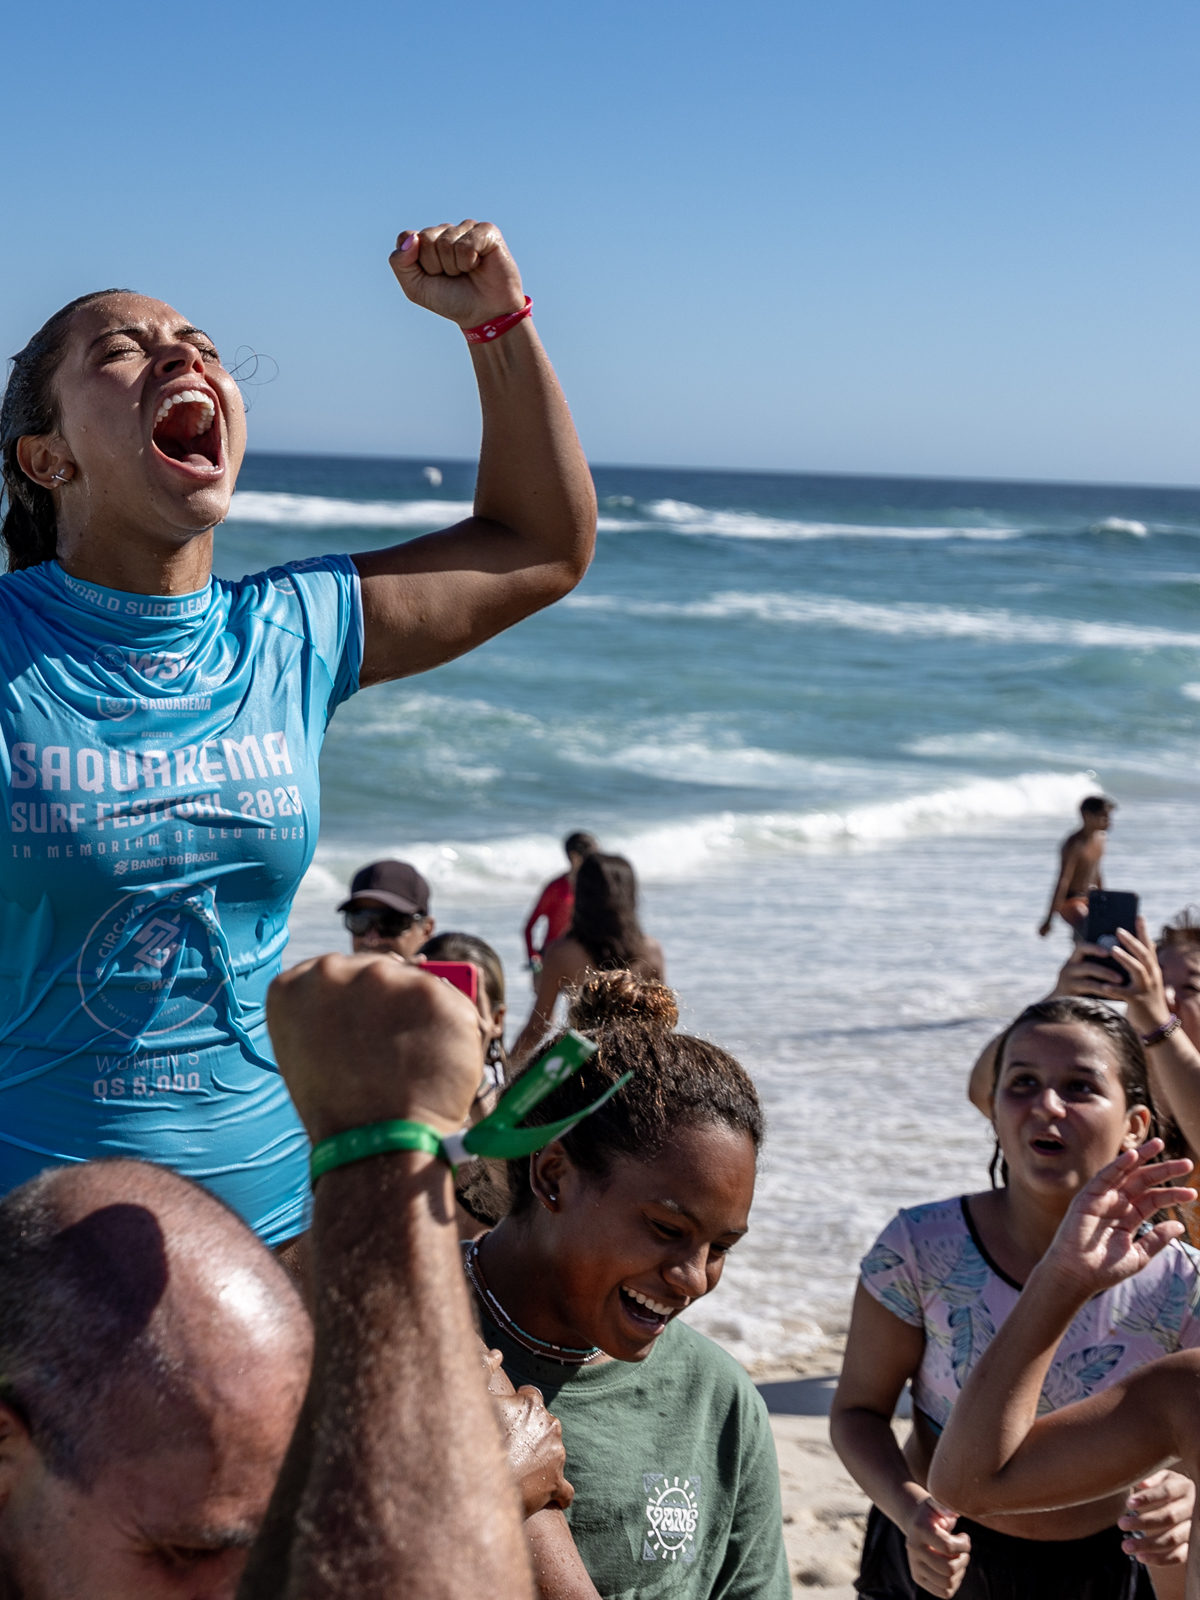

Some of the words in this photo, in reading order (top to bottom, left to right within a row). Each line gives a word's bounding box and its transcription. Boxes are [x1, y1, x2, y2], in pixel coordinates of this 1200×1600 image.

[64, 574, 121, 612] WORLD
[124, 600, 177, 617] SURF
[180, 592, 212, 616] LEAG
[140, 697, 212, 711] SAQUAREMA
[11, 731, 294, 794] SAQUAREMA
[11, 801, 86, 833] SURF
[95, 793, 232, 831] FESTIVAL
[239, 785, 303, 819] 2023
[12, 845, 31, 858] IN
[48, 834, 160, 858] MEMORIAM
[175, 830, 195, 843] OF
[208, 827, 242, 839] LEO
[257, 826, 305, 840] NEVES
[131, 857, 168, 871] BANCO
[168, 855, 184, 866] DO
[184, 852, 219, 864] BRASIL
[151, 976, 177, 990] WS
[96, 1047, 200, 1073] WOMEN'S
[93, 1077, 125, 1101] QS
[133, 1072, 200, 1097] 5,000
[646, 1505, 699, 1532] VANS
